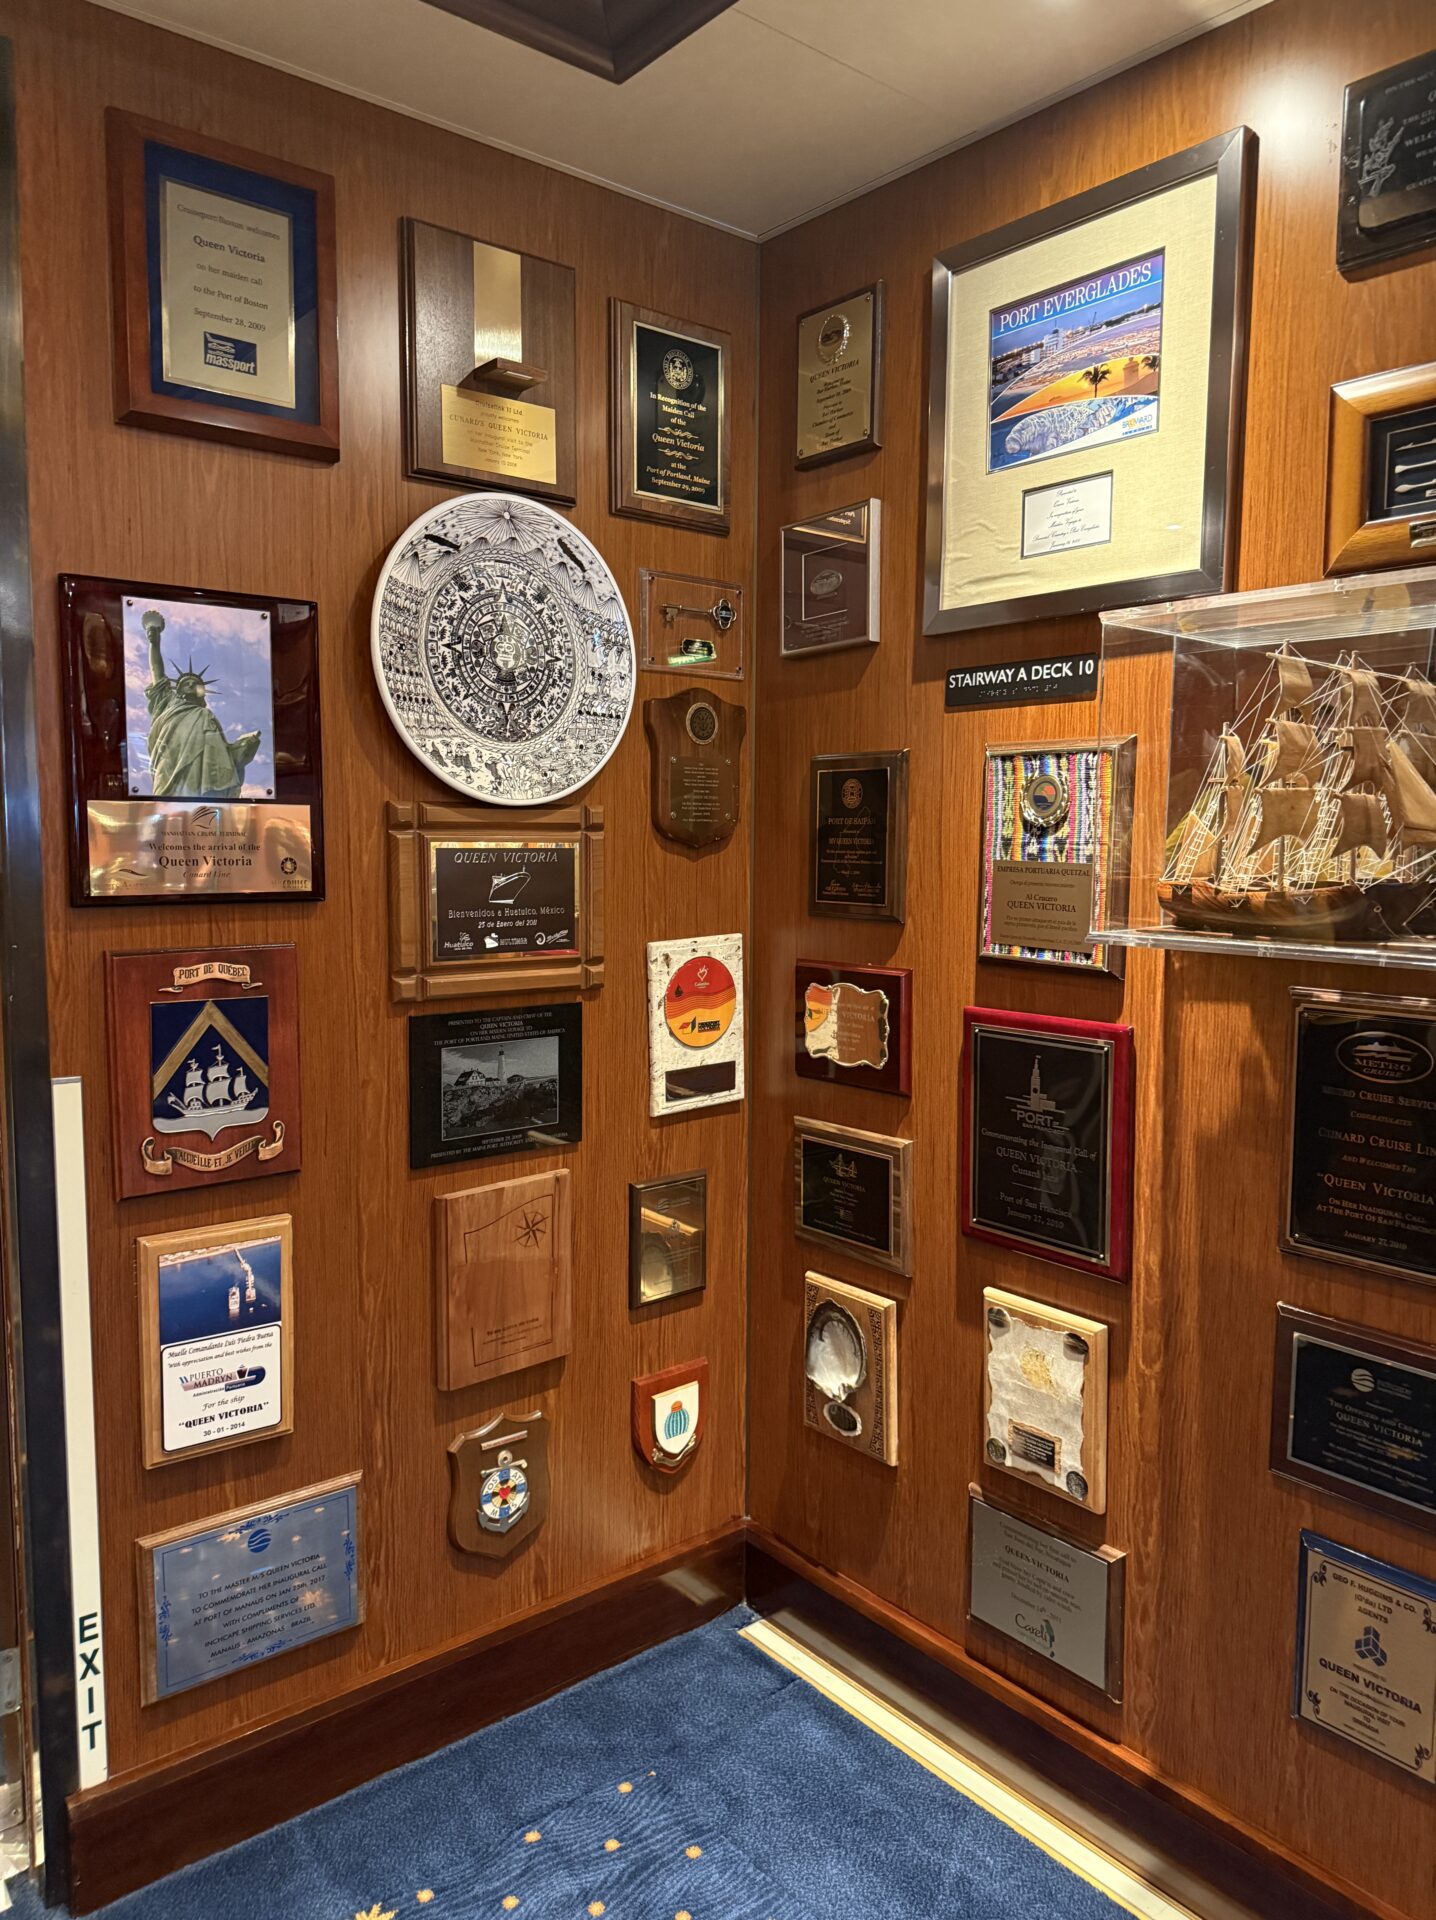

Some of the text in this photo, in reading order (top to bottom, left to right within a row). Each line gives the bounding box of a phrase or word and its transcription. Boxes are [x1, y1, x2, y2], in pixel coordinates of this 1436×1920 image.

[193, 235, 265, 262] Queen Victoria
[208, 265, 220, 274] her
[222, 269, 248, 282] maiden
[251, 277, 263, 286] call
[204, 286, 215, 296] the
[217, 290, 232, 301] Port
[234, 295, 242, 303] of
[244, 297, 268, 310] Boston
[1000, 263, 1152, 332] PORT EVERGLADES
[193, 308, 266, 332] September 28, 2009
[205, 353, 255, 374] massport
[658, 394, 691, 408] Recognition
[691, 402, 697, 411] of
[698, 403, 706, 412] the
[662, 405, 694, 418] Maiden Call
[449, 414, 548, 440] CUNARD'S QUEEN VICTORIA
[670, 417, 676, 425] of
[652, 433, 705, 451] Queen Victoria
[646, 466, 659, 474] Port
[667, 470, 692, 481] Portland,
[693, 476, 711, 484] Maine
[949, 660, 1094, 688] STAIRWAY A DECK 10
[149, 843, 191, 851] Welcomes
[193, 843, 206, 851] the
[454, 852, 558, 863] QUEEN VICTORIA
[159, 855, 252, 868] Queen Victoria
[1061, 868, 1090, 876] QUETZAL
[448, 910, 494, 918] Bienvenidos
[505, 908, 537, 916] Huatulco,
[540, 907, 565, 915] México
[1007, 901, 1076, 913] QUEEN VICTORIA
[178, 963, 248, 980] PORT DE QUÉBEC
[1354, 1058, 1411, 1072] METRO
[1363, 1067, 1401, 1078] CRUISE
[996, 1146, 1078, 1173] QUEEN VICTORIA
[1029, 1138, 1040, 1148] the
[1074, 1146, 1087, 1159] Call
[1089, 1152, 1097, 1161] of
[1000, 1191, 1072, 1218] Port of San Francisco
[168, 1332, 274, 1359] Muelle Comandante Luis Piedra Buena
[181, 1355, 213, 1367] appreciation
[189, 1368, 224, 1381] PUERTO
[193, 1373, 232, 1389] MADRYN
[202, 1395, 245, 1411] For the ship
[216, 1425, 224, 1433] 01
[231, 1422, 245, 1430] 2014
[1336, 1412, 1370, 1428] QUEEN
[1373, 1423, 1423, 1447] VICTORIA
[1005, 1544, 1030, 1562] QUEEN
[1031, 1558, 1069, 1583] VICTORIA
[199, 1591, 209, 1599] TO
[210, 1587, 223, 1596] THE
[224, 1577, 250, 1591] MASTER
[266, 1564, 290, 1577] QUEEN
[290, 1553, 320, 1568] VICTORIA
[192, 1563, 327, 1615] TO COMMEMORATE HER INAUGURAL CALL
[203, 1612, 222, 1623] PORT
[223, 1608, 233, 1617] OF
[234, 1596, 264, 1611] MANAUS
[265, 1592, 277, 1602] ON
[278, 1588, 291, 1598] JAN
[310, 1575, 326, 1586] 2017
[1333, 1573, 1348, 1584] GEO
[1350, 1580, 1356, 1588] F.
[1358, 1583, 1393, 1603] HUGGINS
[1403, 1603, 1416, 1613] CO.
[222, 1596, 300, 1629] WITH COMPLIMENTS OF
[1357, 1606, 1388, 1624] AGENTS
[204, 1630, 240, 1647] INCHCAPE
[241, 1619, 273, 1633] SHIPPING
[274, 1608, 303, 1624] SERVICES
[210, 1616, 311, 1658] MANAUS AMAZONAS BRAZIL
[79, 1612, 102, 1750] EXIT
[1319, 1657, 1422, 1714] QUEEN VICTORIA
